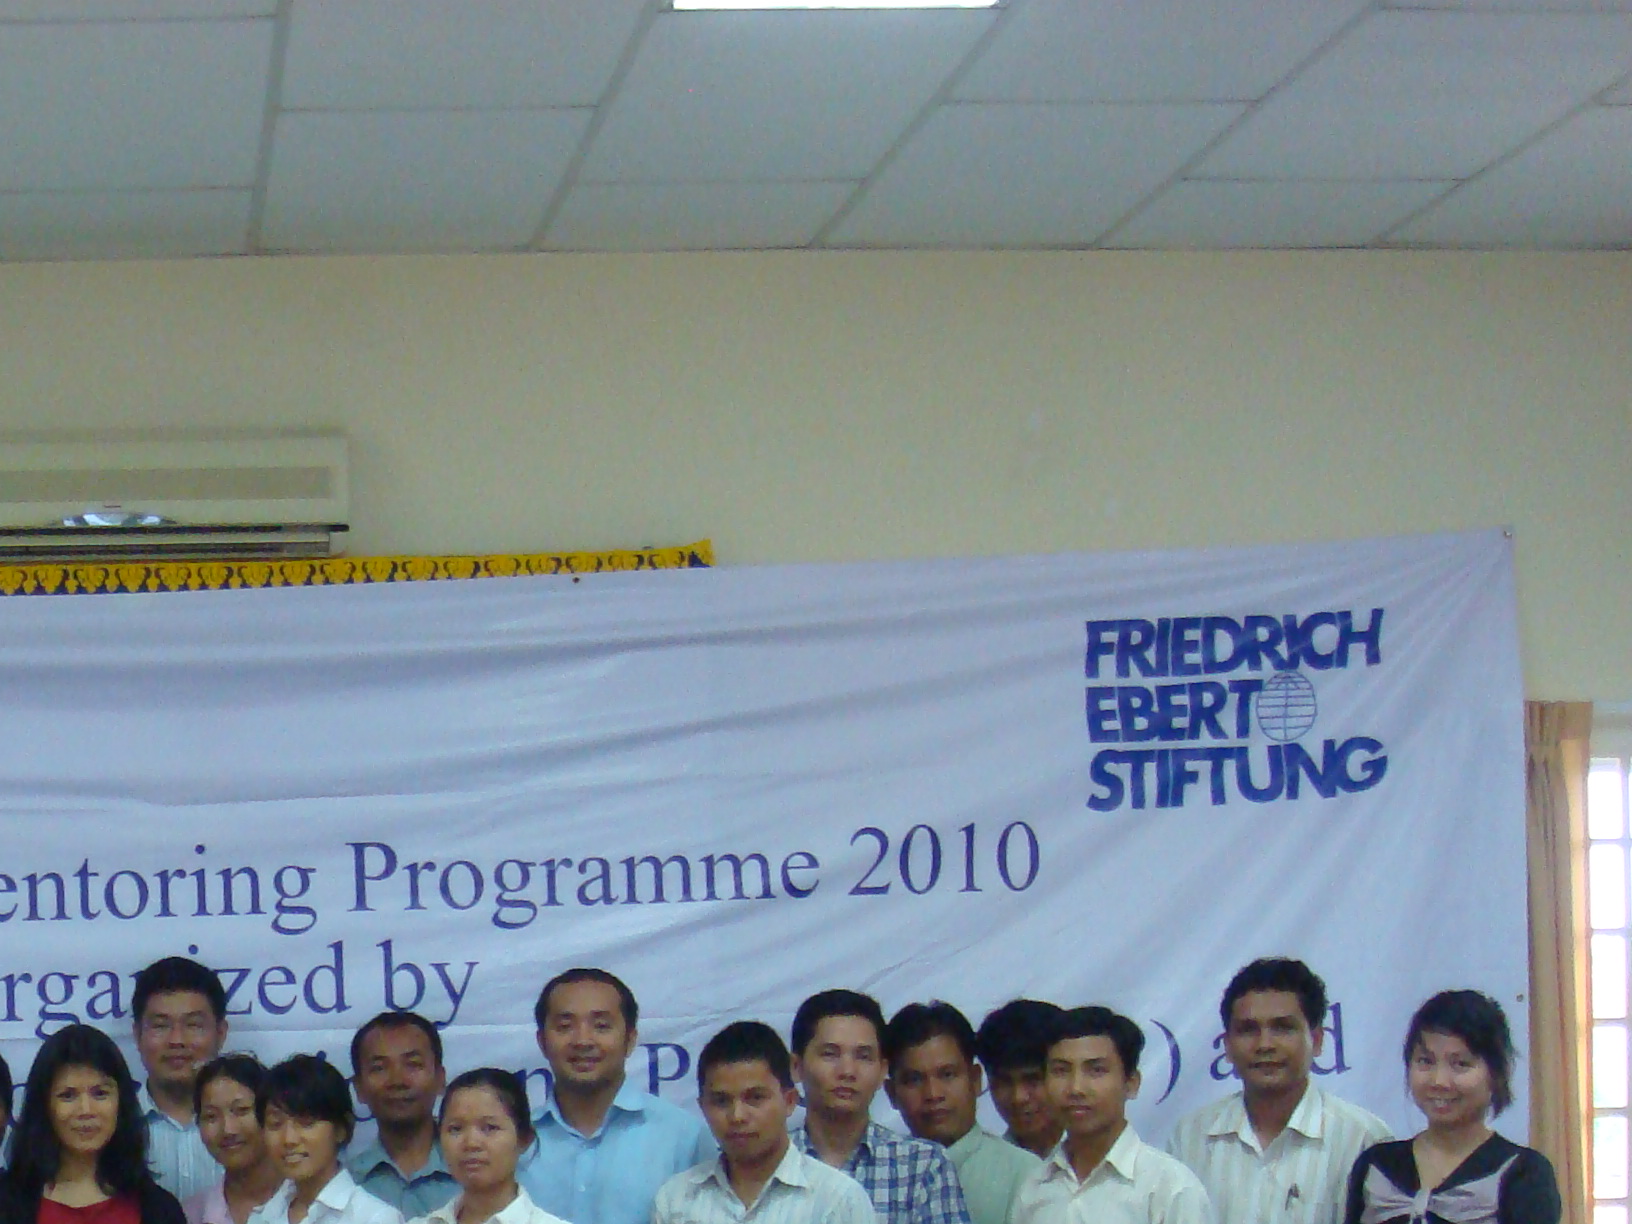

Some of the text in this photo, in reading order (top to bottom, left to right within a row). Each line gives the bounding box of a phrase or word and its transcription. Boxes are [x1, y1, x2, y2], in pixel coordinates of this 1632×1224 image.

[1084, 608, 1384, 679] FRIEDRICH
[1085, 679, 1264, 743] EBERT
[1086, 736, 1388, 812] STIFTUNG
[344, 840, 821, 930] Programme
[846, 820, 1040, 896] 2010
[376, 938, 480, 1031] by
